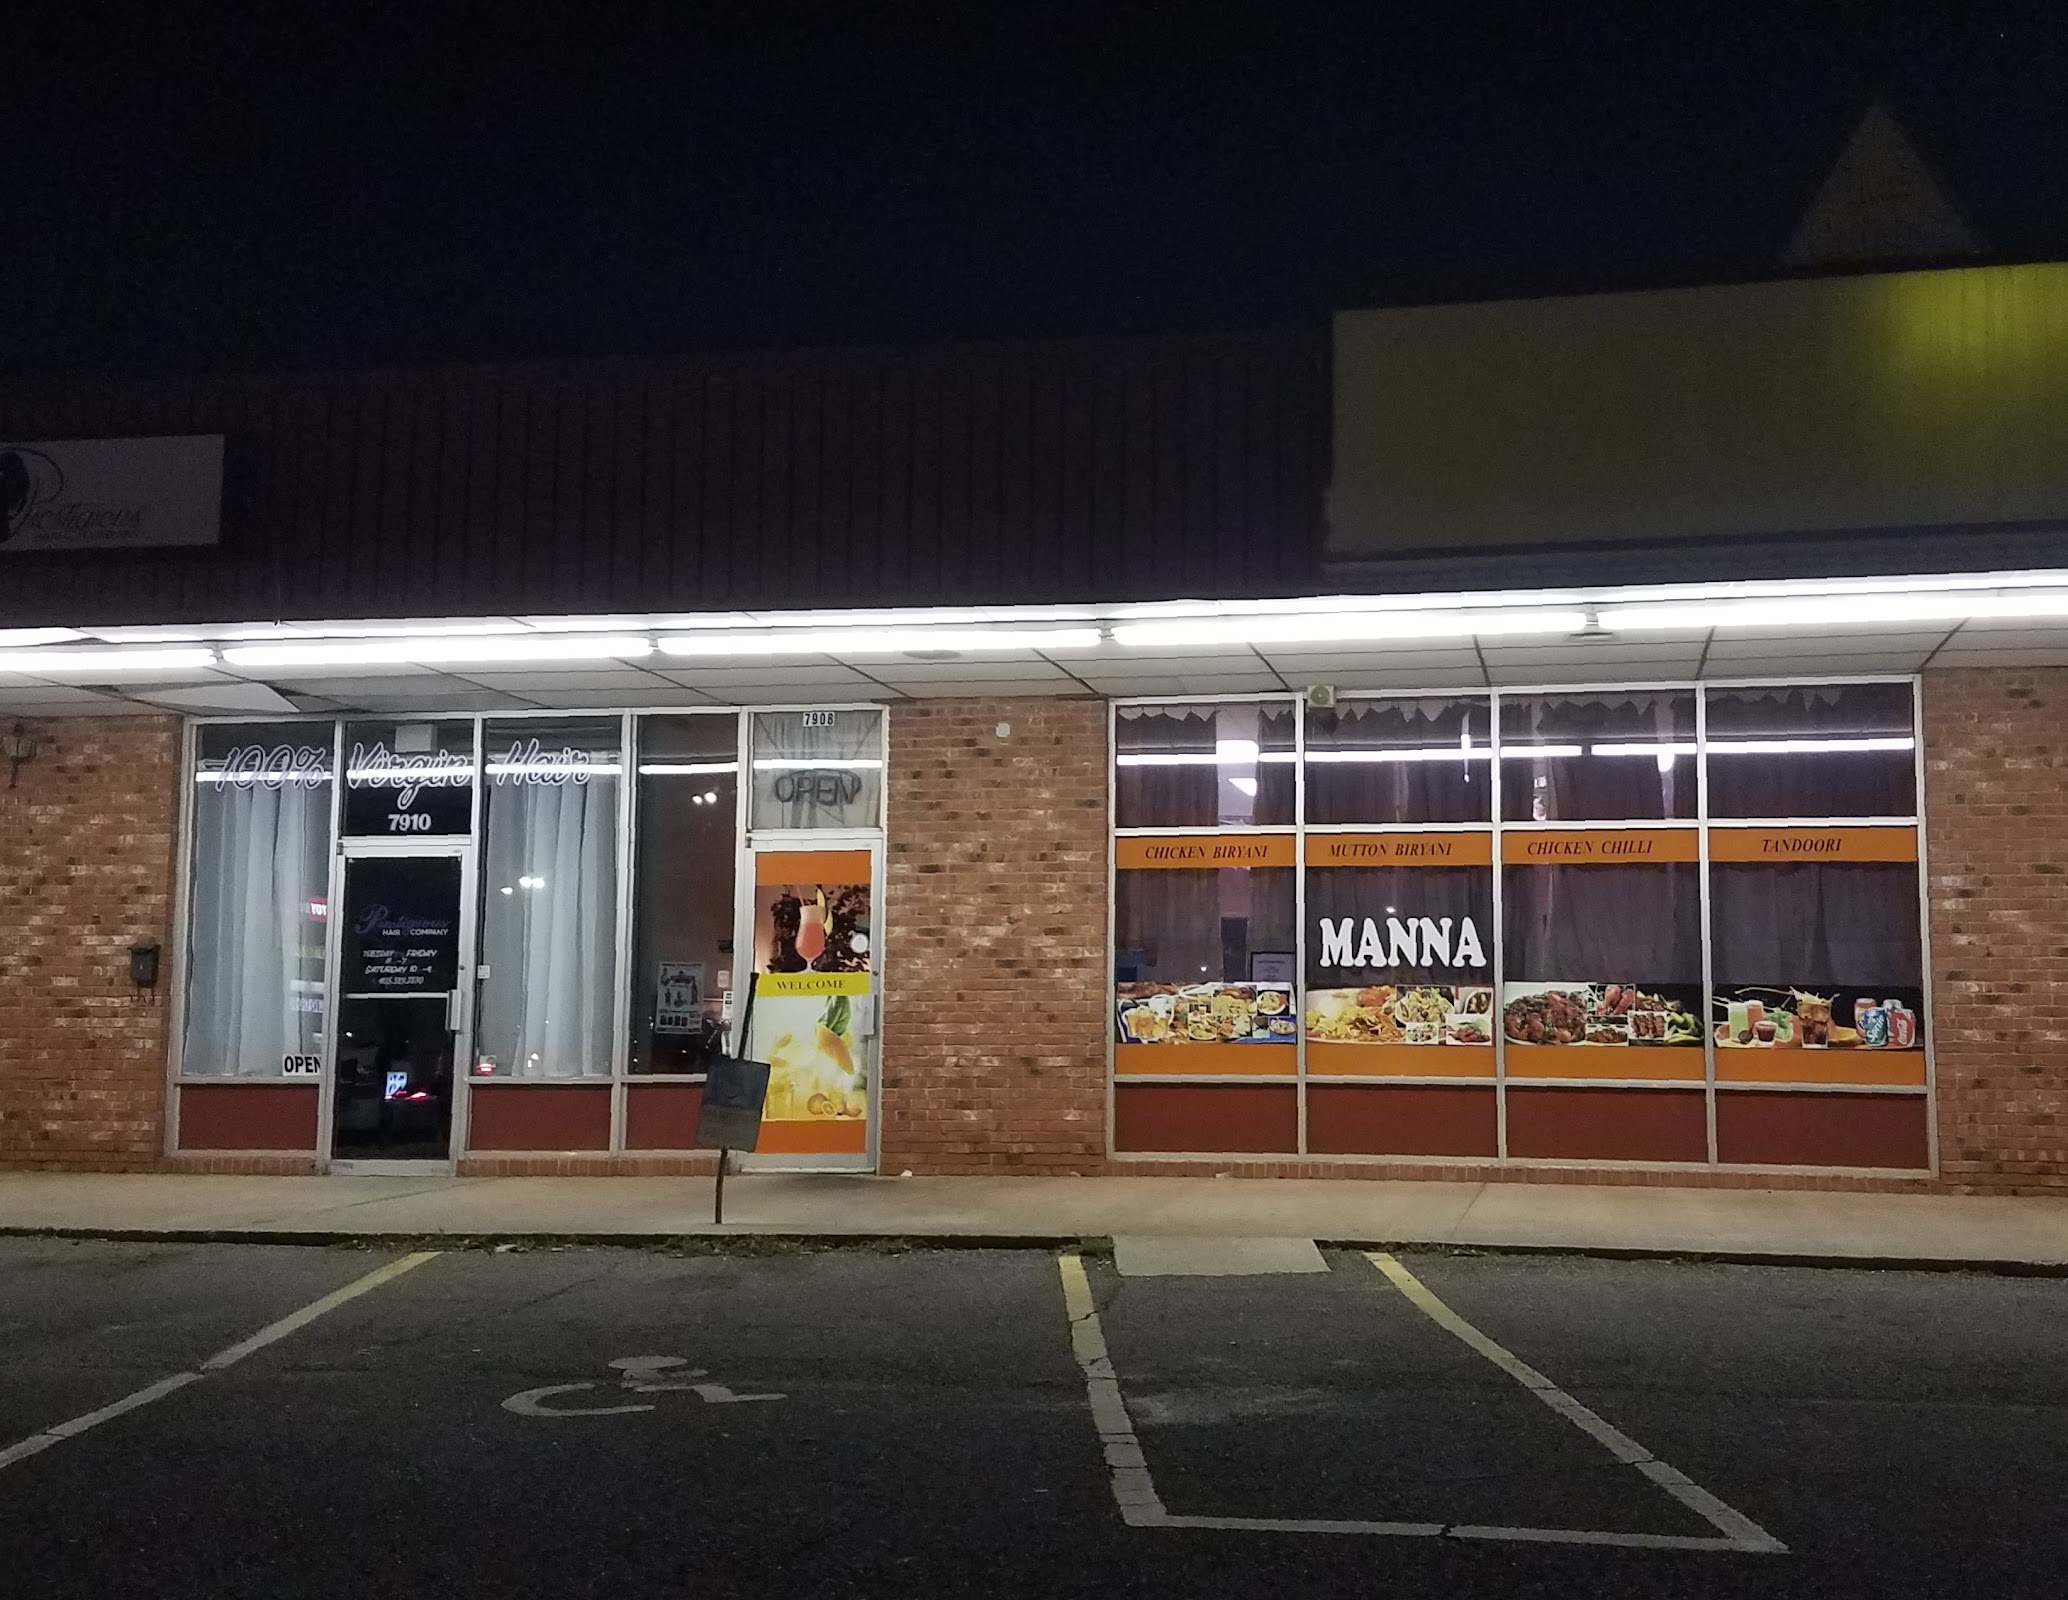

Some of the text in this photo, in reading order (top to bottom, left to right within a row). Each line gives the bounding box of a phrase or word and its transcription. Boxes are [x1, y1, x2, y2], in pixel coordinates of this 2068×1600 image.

[804, 712, 834, 725] 7908
[216, 738, 590, 810] 100% Virgin Hair
[774, 774, 859, 806] OPEN
[387, 813, 432, 832] 7910
[1145, 844, 1268, 859] CHICKEN BIRYANI
[1329, 842, 1452, 857] MUTTON BIRYANI
[1527, 840, 1653, 855] CHICKEN CHILLI
[1762, 838, 1842, 853] TANDOORI
[382, 928, 449, 936] HAIR COMPANY
[1319, 917, 1487, 967] MANNA
[776, 979, 846, 990] WELCOME
